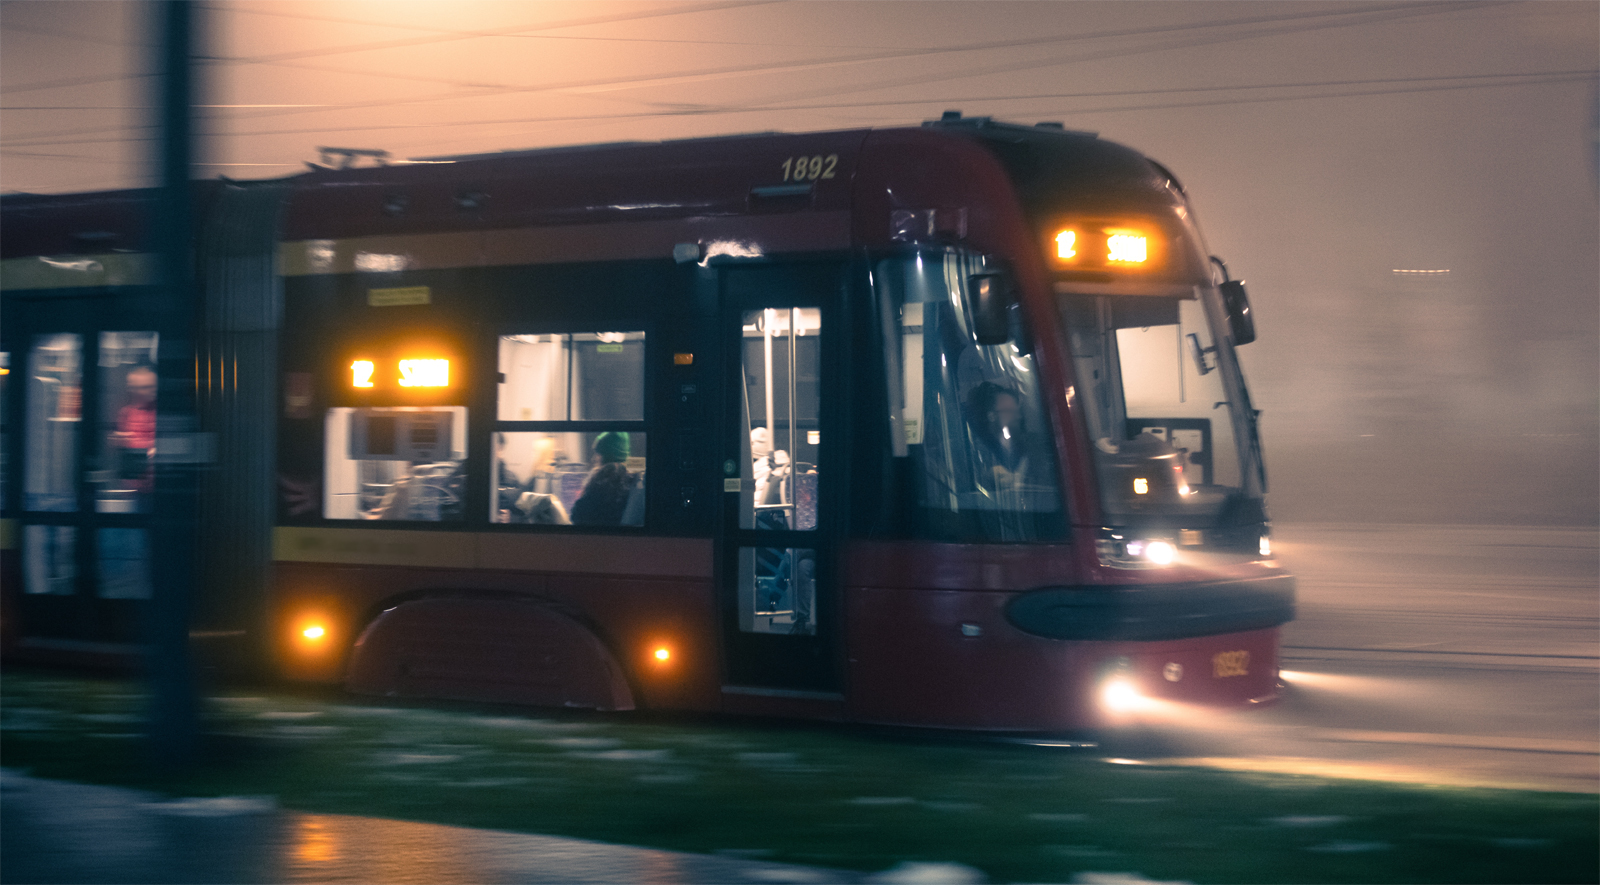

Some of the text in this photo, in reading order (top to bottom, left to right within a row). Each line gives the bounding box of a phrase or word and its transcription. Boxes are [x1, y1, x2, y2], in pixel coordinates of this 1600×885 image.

[781, 154, 839, 182] 1892
[1055, 230, 1077, 258] 12
[350, 360, 375, 388] 12
